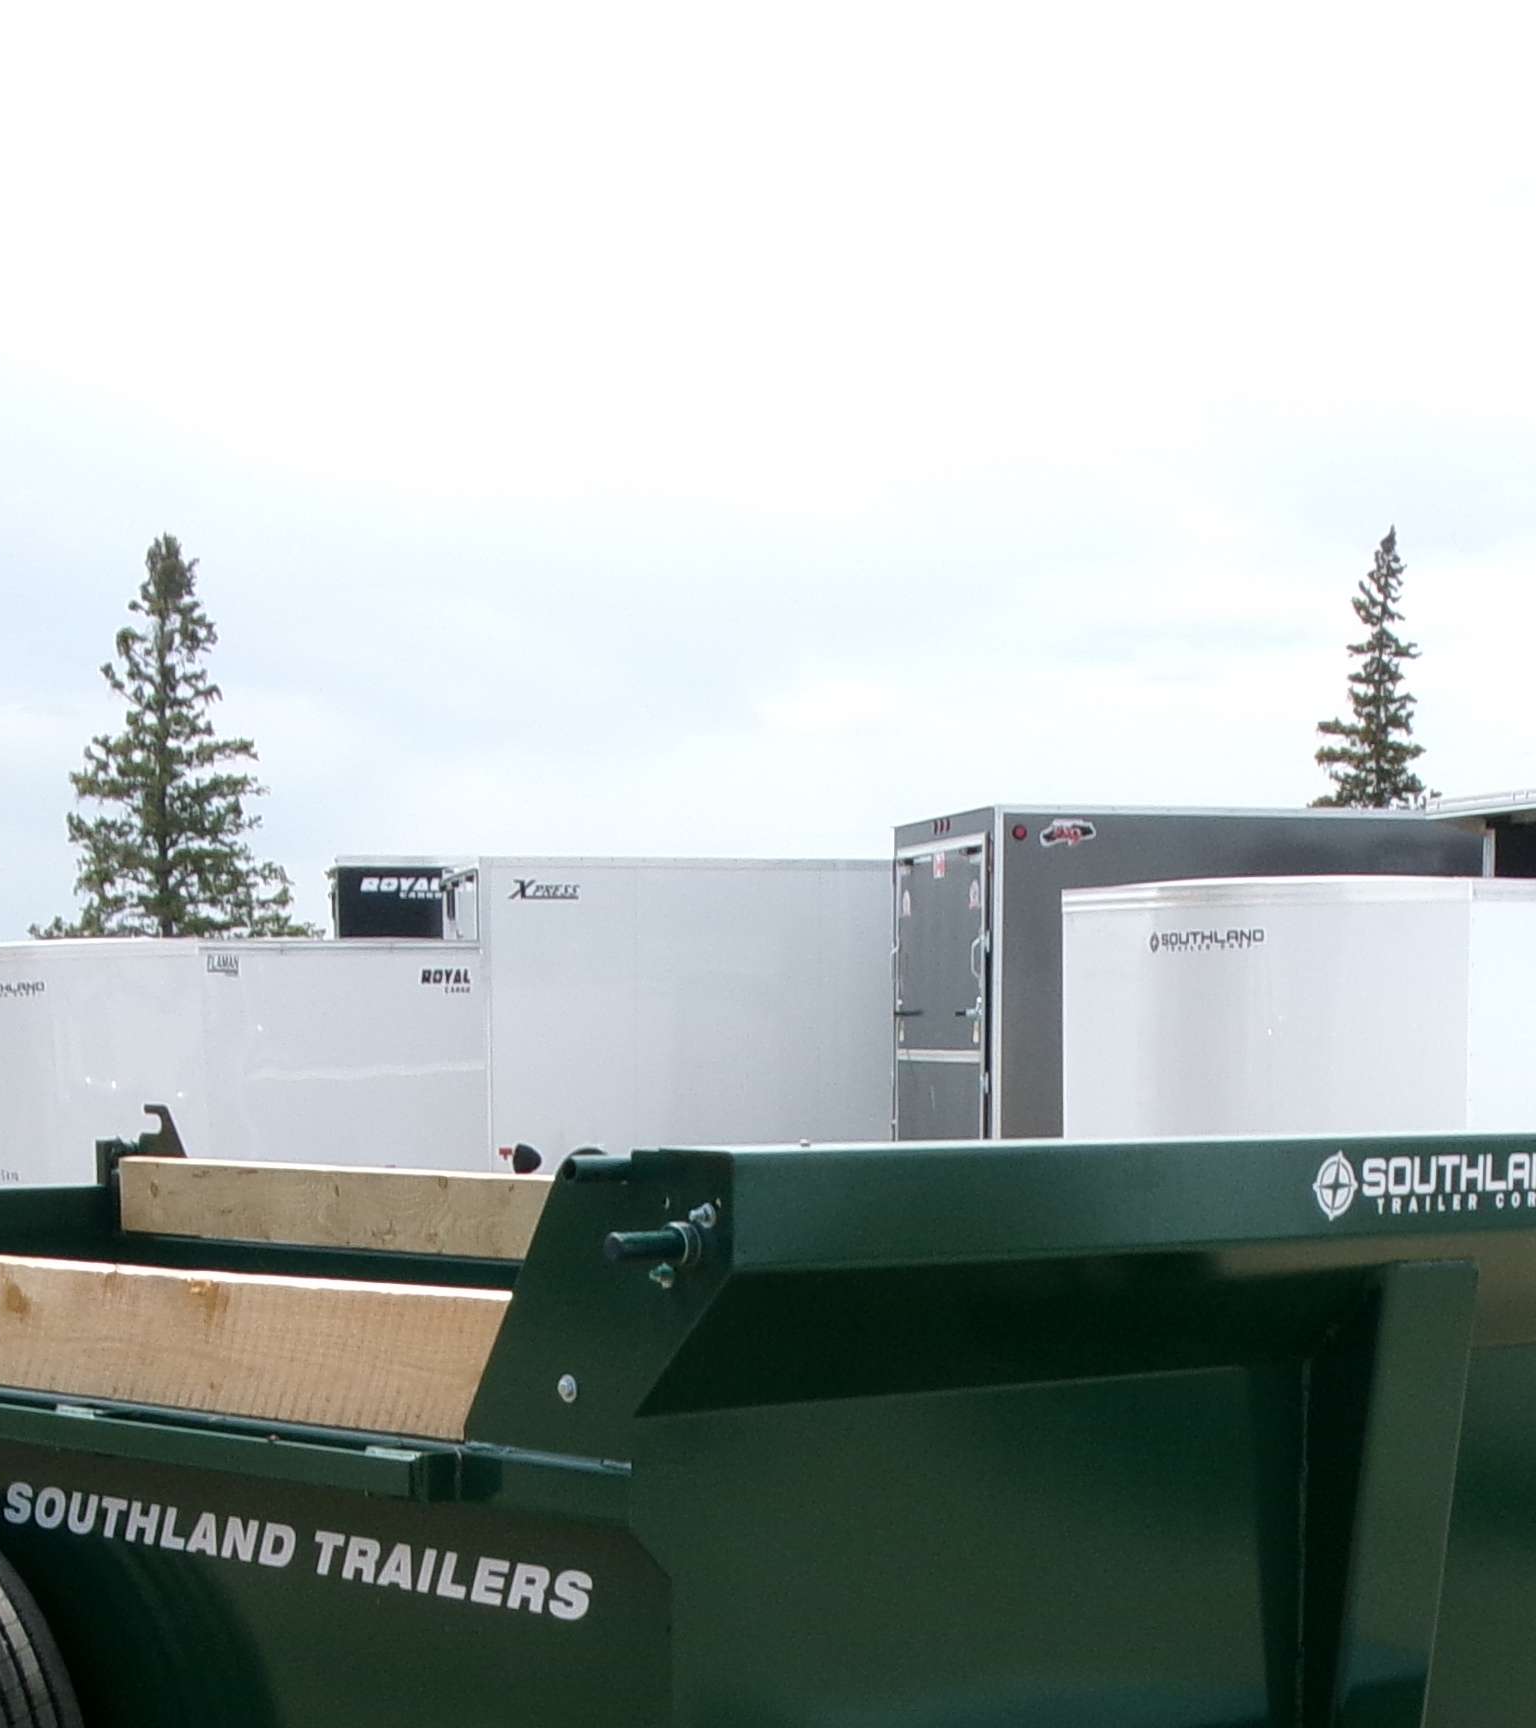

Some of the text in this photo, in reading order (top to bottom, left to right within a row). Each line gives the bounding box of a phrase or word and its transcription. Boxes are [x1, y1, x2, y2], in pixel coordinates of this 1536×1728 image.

[1161, 929, 1265, 946] SOUTHLAND
[421, 969, 471, 985] ROYAL
[1377, 1193, 1478, 1215] TRAILER
[2, 1481, 594, 1621] SOUTHLAND TRAILERS
